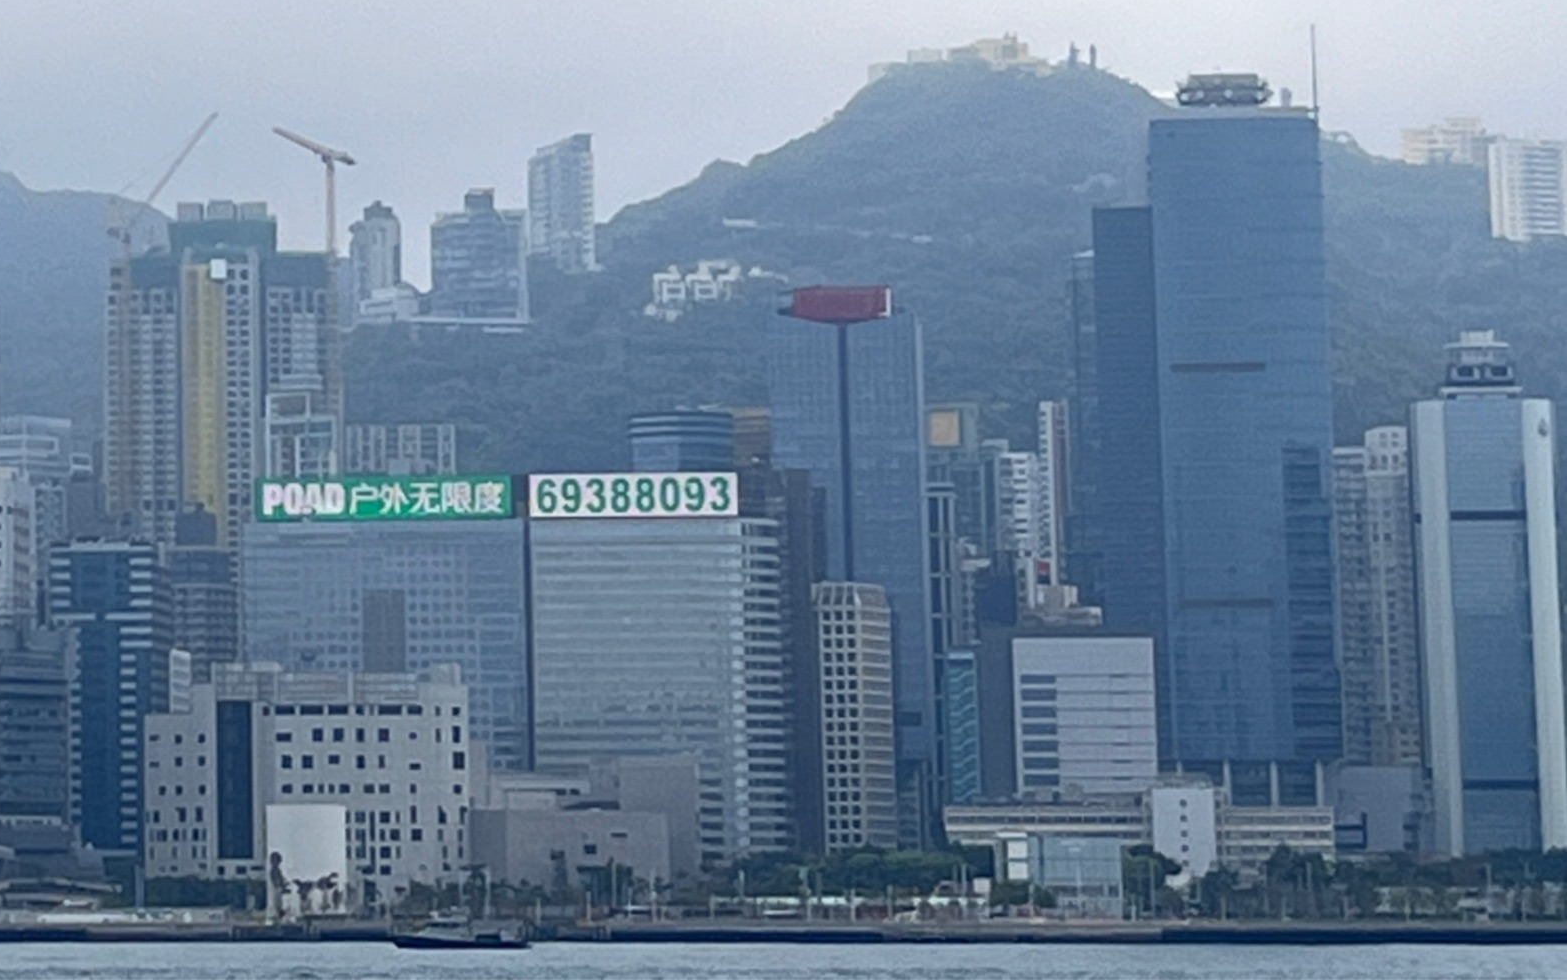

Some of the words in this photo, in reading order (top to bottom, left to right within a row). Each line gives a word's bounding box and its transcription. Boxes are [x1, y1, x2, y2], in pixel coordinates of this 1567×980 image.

[262, 482, 345, 516] POAD
[349, 480, 505, 515] 户外无限度
[537, 477, 731, 513] 69388093
